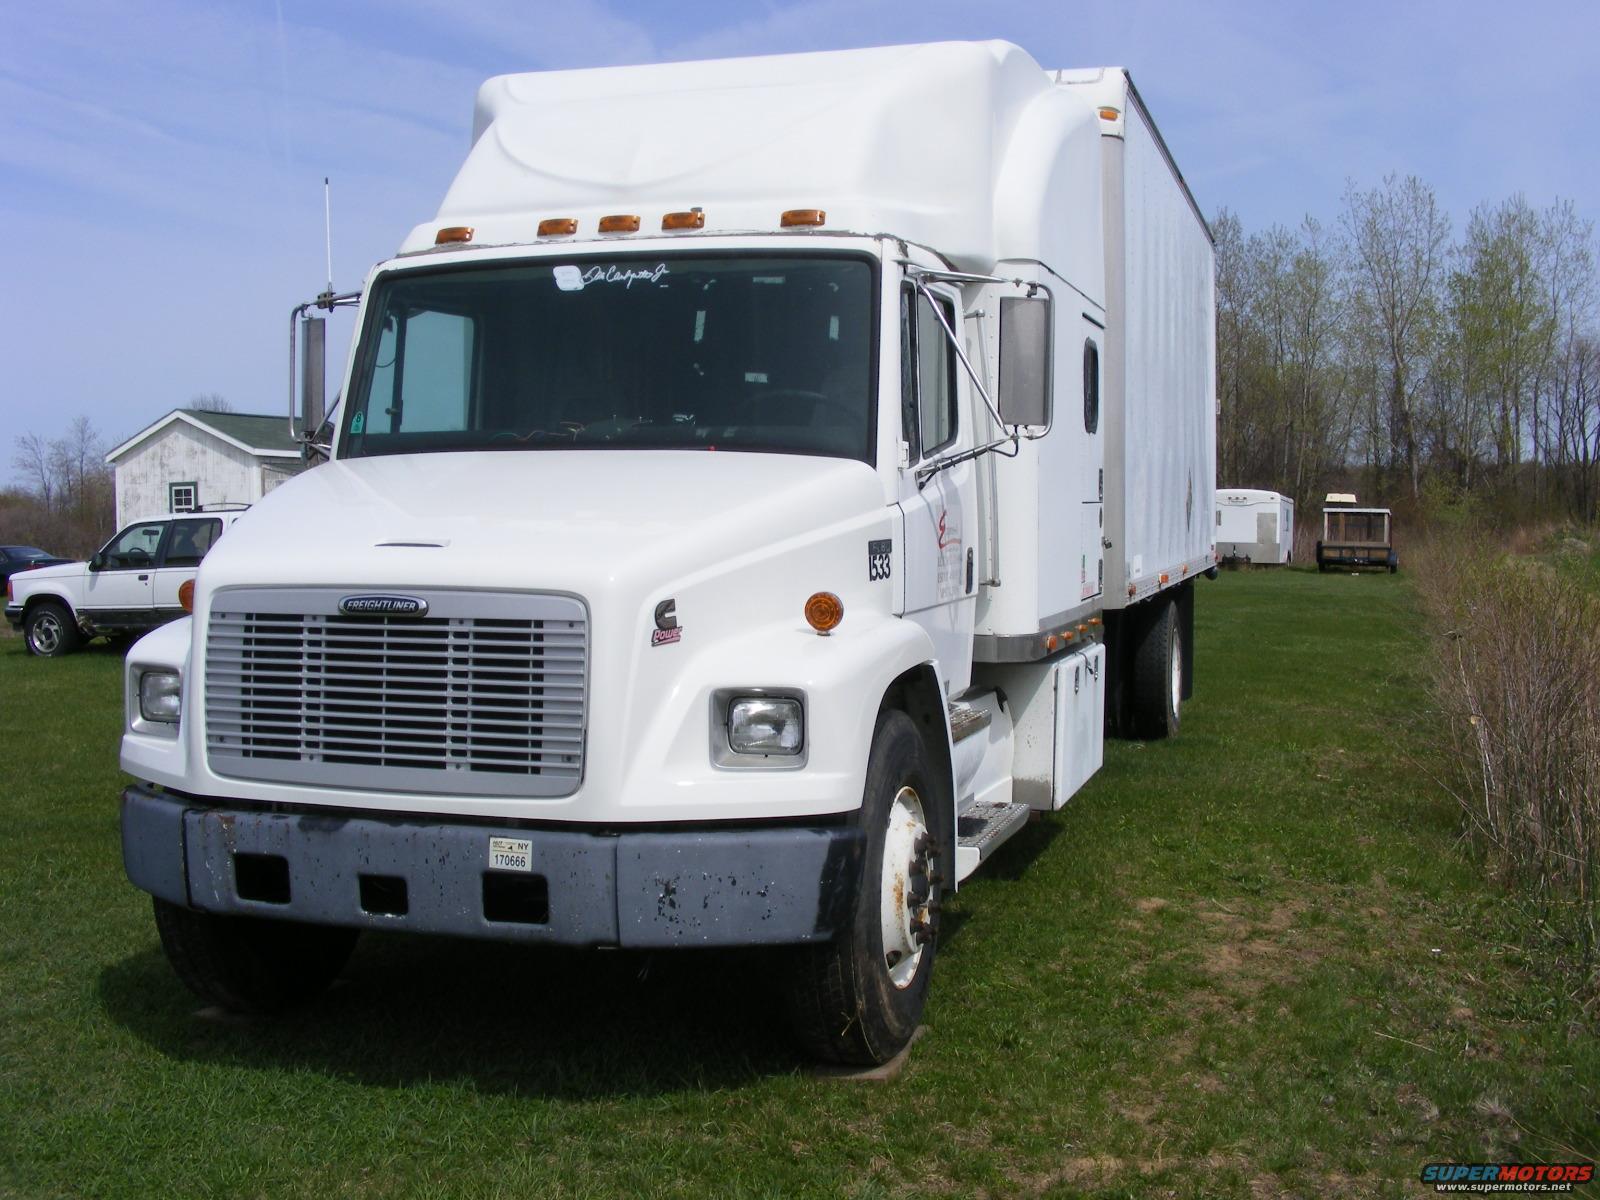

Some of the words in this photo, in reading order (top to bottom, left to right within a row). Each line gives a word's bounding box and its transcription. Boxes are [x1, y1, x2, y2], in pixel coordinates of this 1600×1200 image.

[345, 599, 417, 611] FREIGHTLINER
[517, 842, 529, 851] NY
[494, 853, 527, 868] 170666
